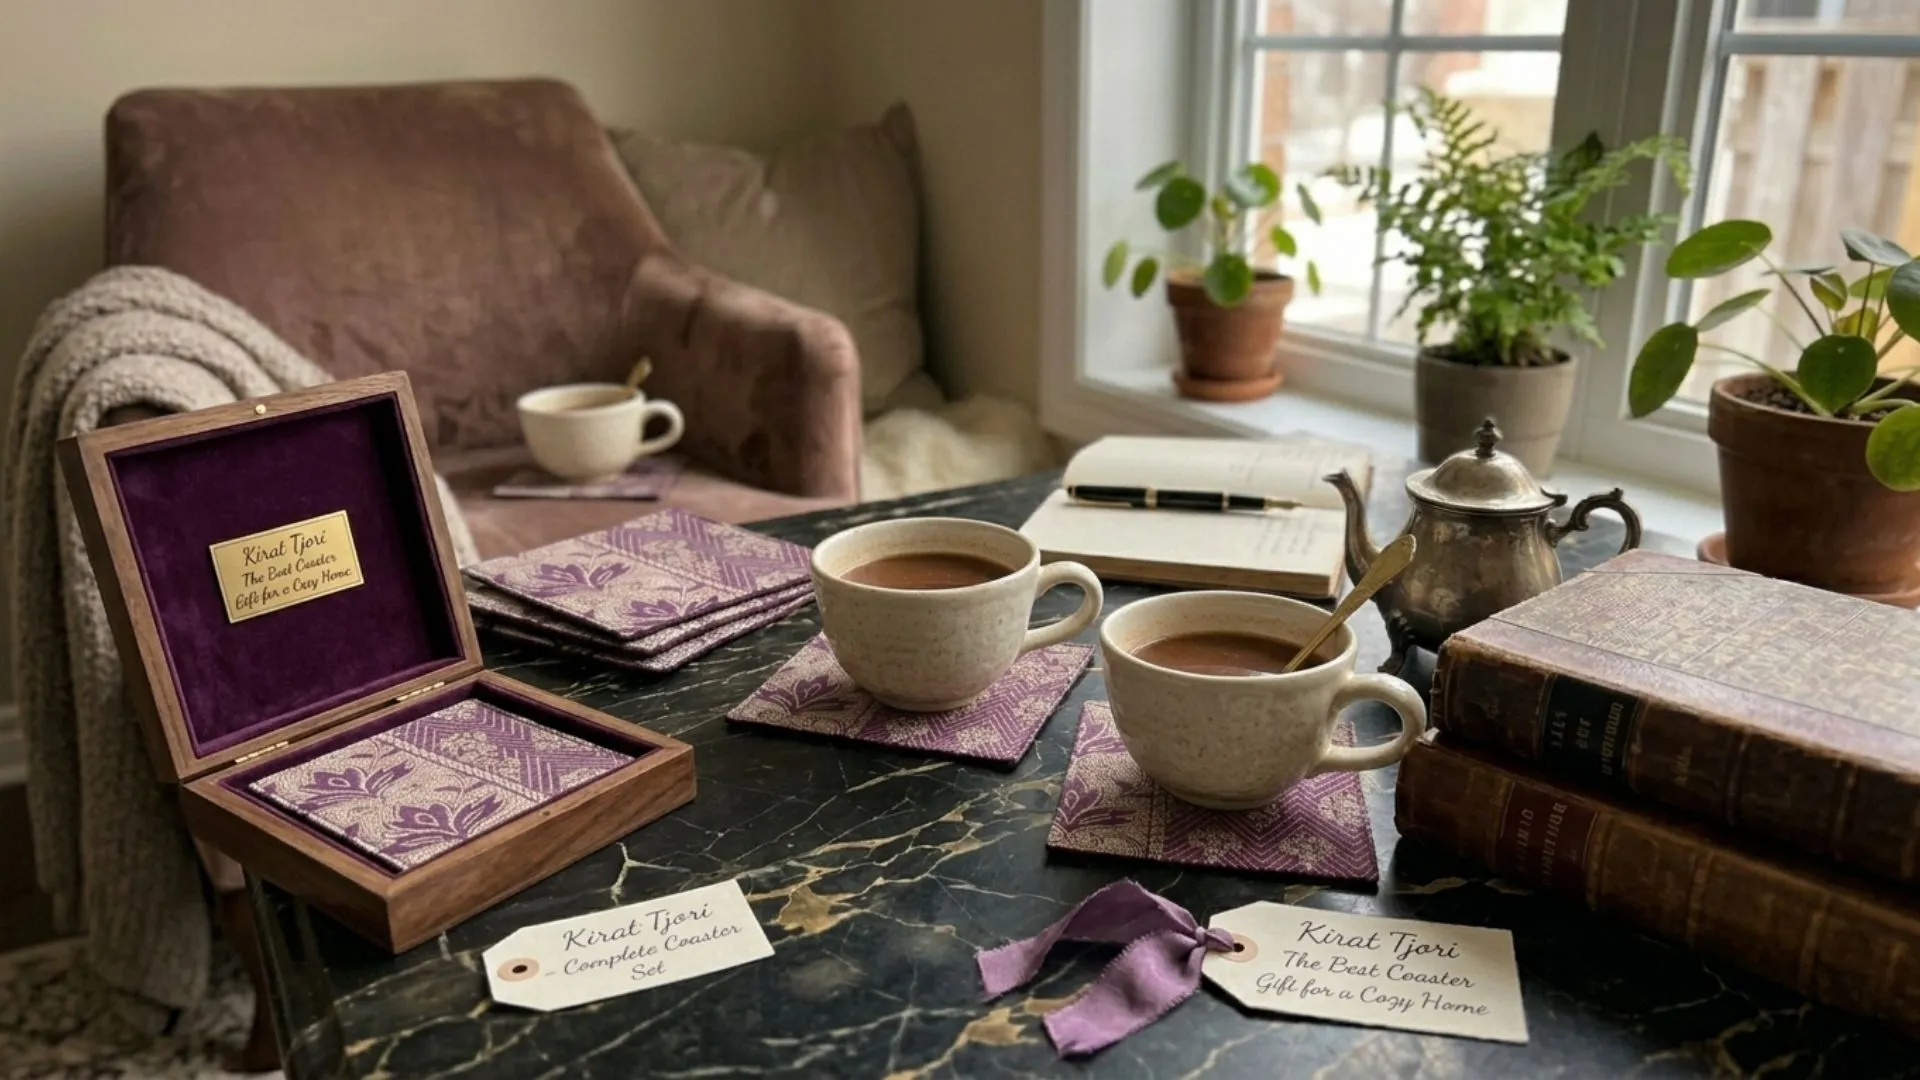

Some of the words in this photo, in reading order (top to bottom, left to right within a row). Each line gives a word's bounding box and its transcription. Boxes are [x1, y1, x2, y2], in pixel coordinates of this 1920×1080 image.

[242, 540, 286, 566] Kirat
[290, 530, 327, 556] Tjori
[241, 572, 264, 587] The
[563, 919, 641, 951] Kirat
[645, 903, 713, 936] Tjori
[1297, 920, 1381, 950] Kirat
[1389, 931, 1461, 961] Tjori
[563, 945, 658, 976] Complete
[664, 925, 743, 952] Coaster
[1283, 950, 1322, 972] The
[1327, 955, 1380, 977] Best
[1386, 964, 1476, 989] Coaster
[630, 961, 667, 982] Set
[1255, 972, 1298, 996] Gift
[1296, 979, 1334, 1001] for
[1338, 988, 1354, 1000] a
[1360, 986, 1414, 1011] Cozy
[1421, 992, 1491, 1016] Home
